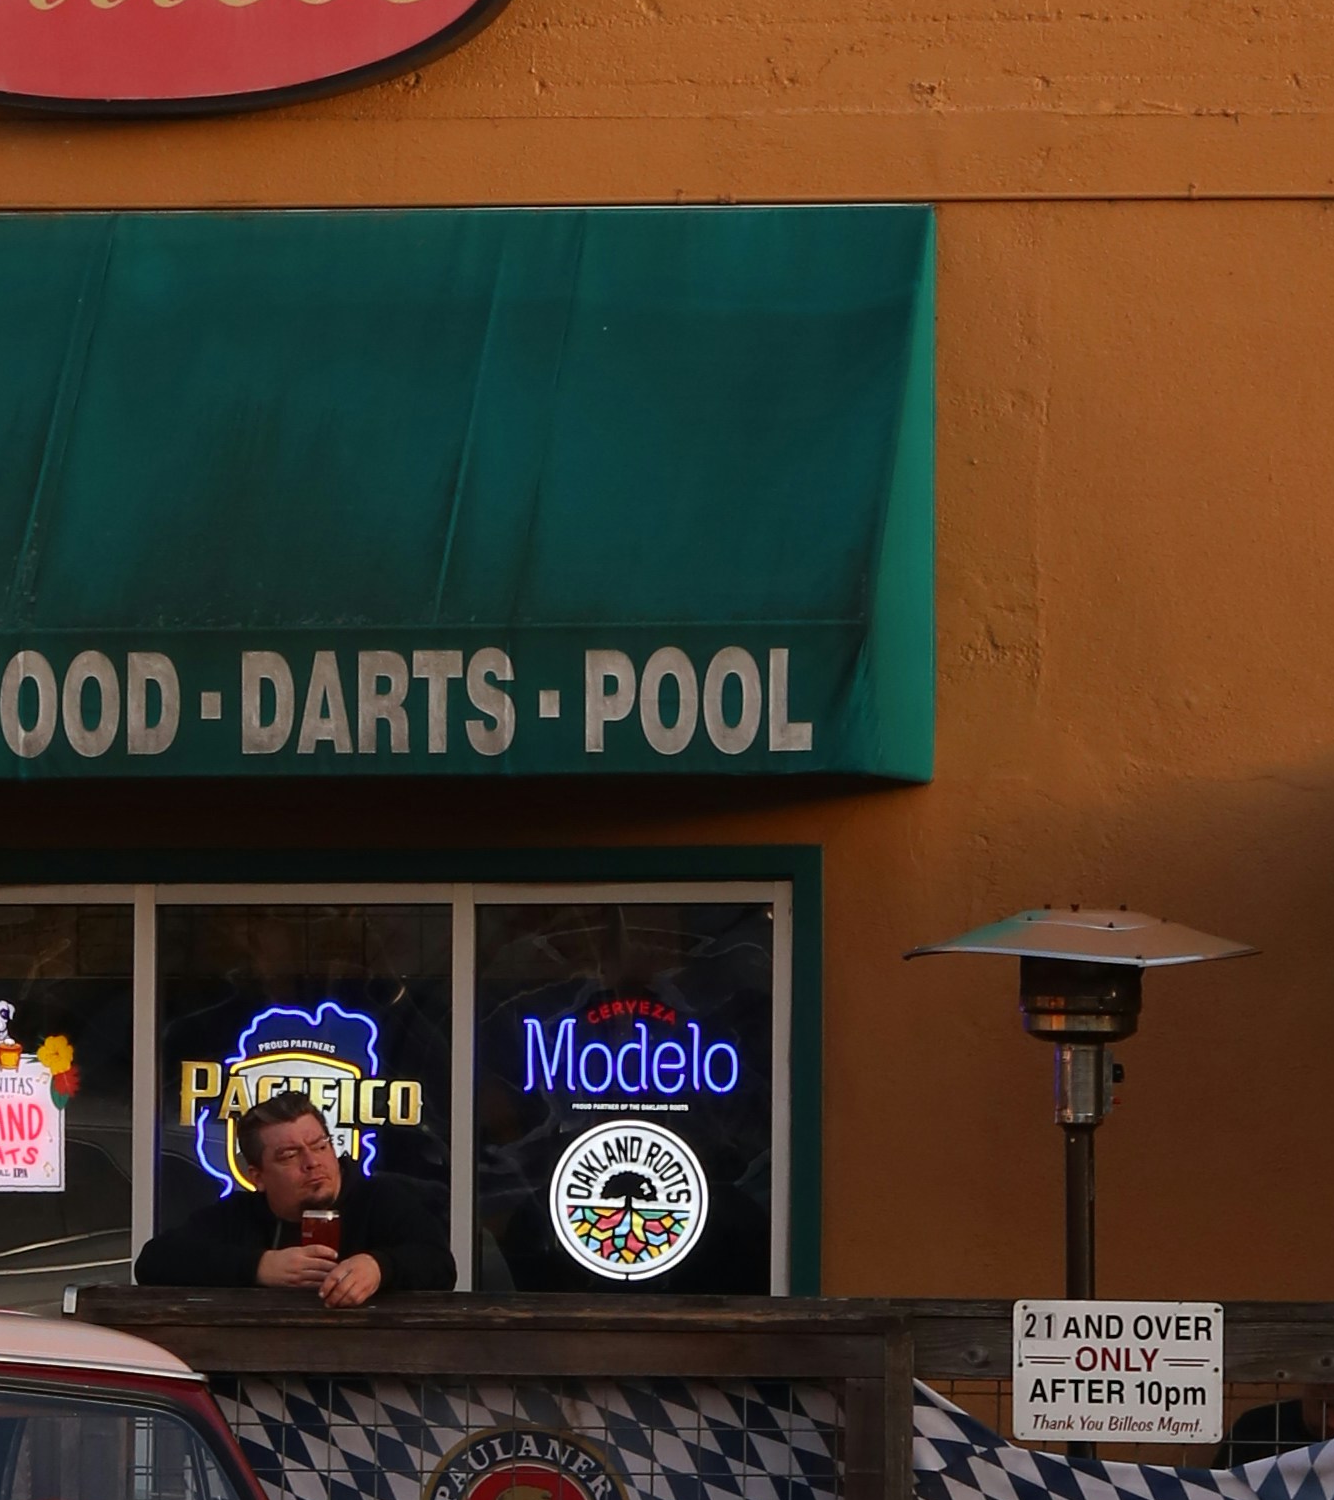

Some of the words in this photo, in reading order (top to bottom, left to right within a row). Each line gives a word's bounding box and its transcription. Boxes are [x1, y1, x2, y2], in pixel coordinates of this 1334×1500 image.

[240, 647, 516, 757] DARTS
[584, 645, 813, 755] POOL
[587, 1000, 677, 1025] CERVEZA
[258, 1040, 289, 1053] PROUD
[290, 1039, 336, 1054] PARTNERS
[522, 1017, 740, 1094] Modelo
[13, 1168, 29, 1179] IPA
[566, 1136, 643, 1200] OAKLAND
[643, 1140, 692, 1204] ROOTS
[1024, 1313, 1053, 1338] 21
[1062, 1315, 1124, 1339] AND
[1133, 1315, 1212, 1341] OVER
[1075, 1346, 1159, 1372] ONLY
[1029, 1378, 1124, 1404] AFTER
[1135, 1381, 1206, 1412] 10pm
[1033, 1414, 1075, 1430] Thank
[1080, 1416, 1104, 1431] You
[1108, 1416, 1154, 1432] Billcos
[1157, 1417, 1203, 1436] Mgmt.
